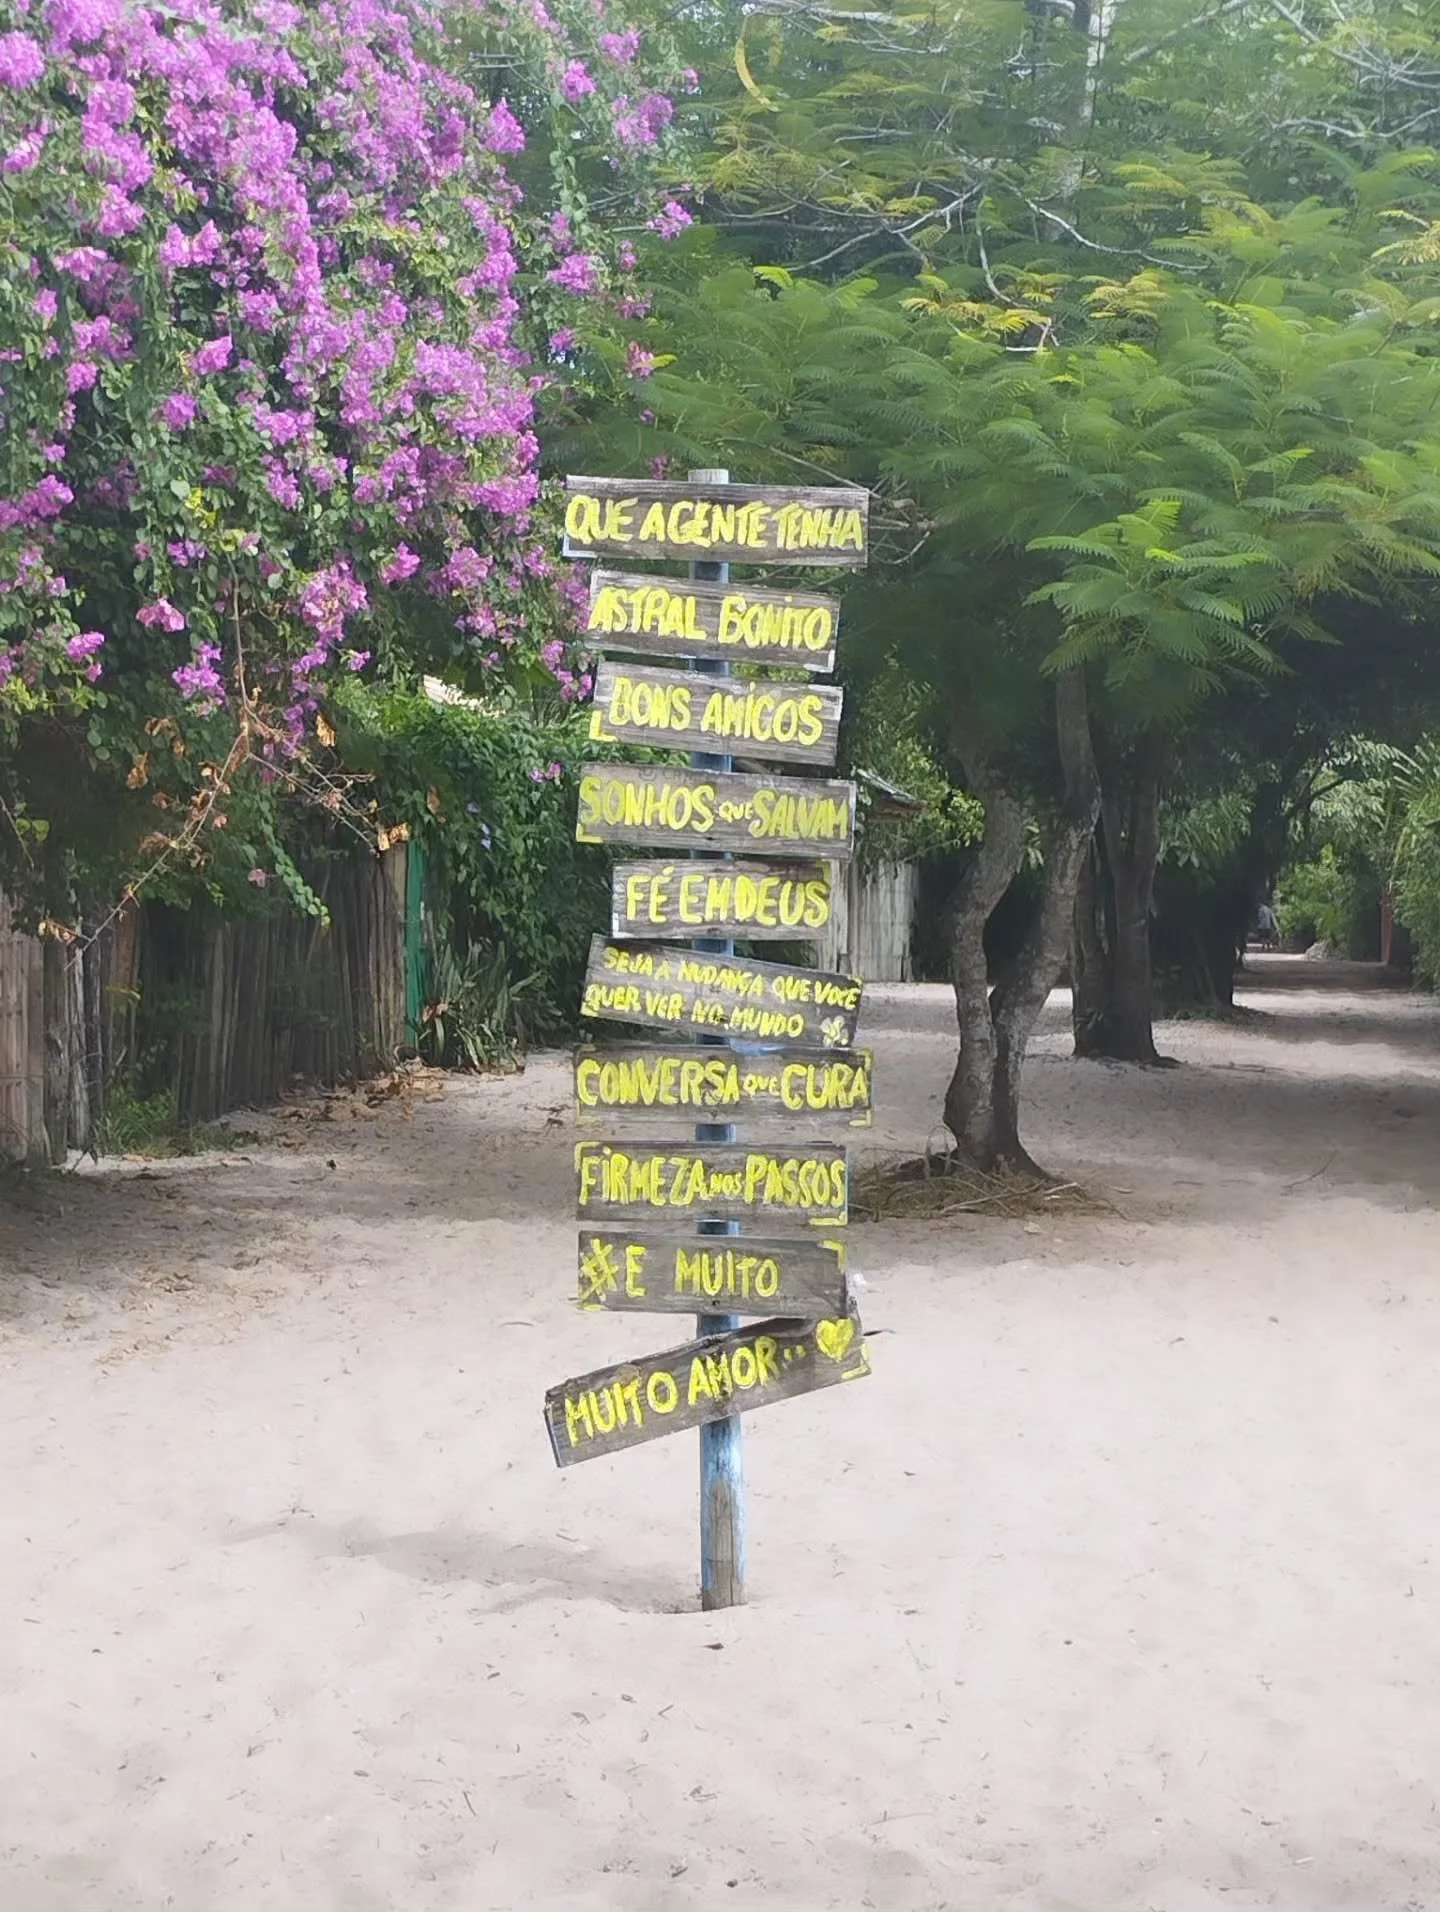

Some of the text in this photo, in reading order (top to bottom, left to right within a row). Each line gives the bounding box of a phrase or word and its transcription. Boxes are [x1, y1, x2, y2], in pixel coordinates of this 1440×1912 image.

[565, 494, 638, 544] QUE
[772, 501, 864, 550] TENHA
[587, 586, 707, 640] ASTRAL
[608, 676, 692, 731] BONS
[579, 776, 848, 840] SONHOS QUE SALVAM
[626, 865, 830, 928] FÉ EM DEUS
[583, 983, 642, 1014] QUER
[645, 990, 684, 1021] VER
[602, 946, 653, 976] SEJA
[654, 960, 671, 981] A
[771, 975, 813, 1005] QUE
[577, 1057, 870, 1110] CONVERSA QUE CURA
[579, 1146, 846, 1208] FIRMEZA NOS PASSOS
[674, 1247, 780, 1299] MUITO
[564, 1370, 678, 1447] MUITO
